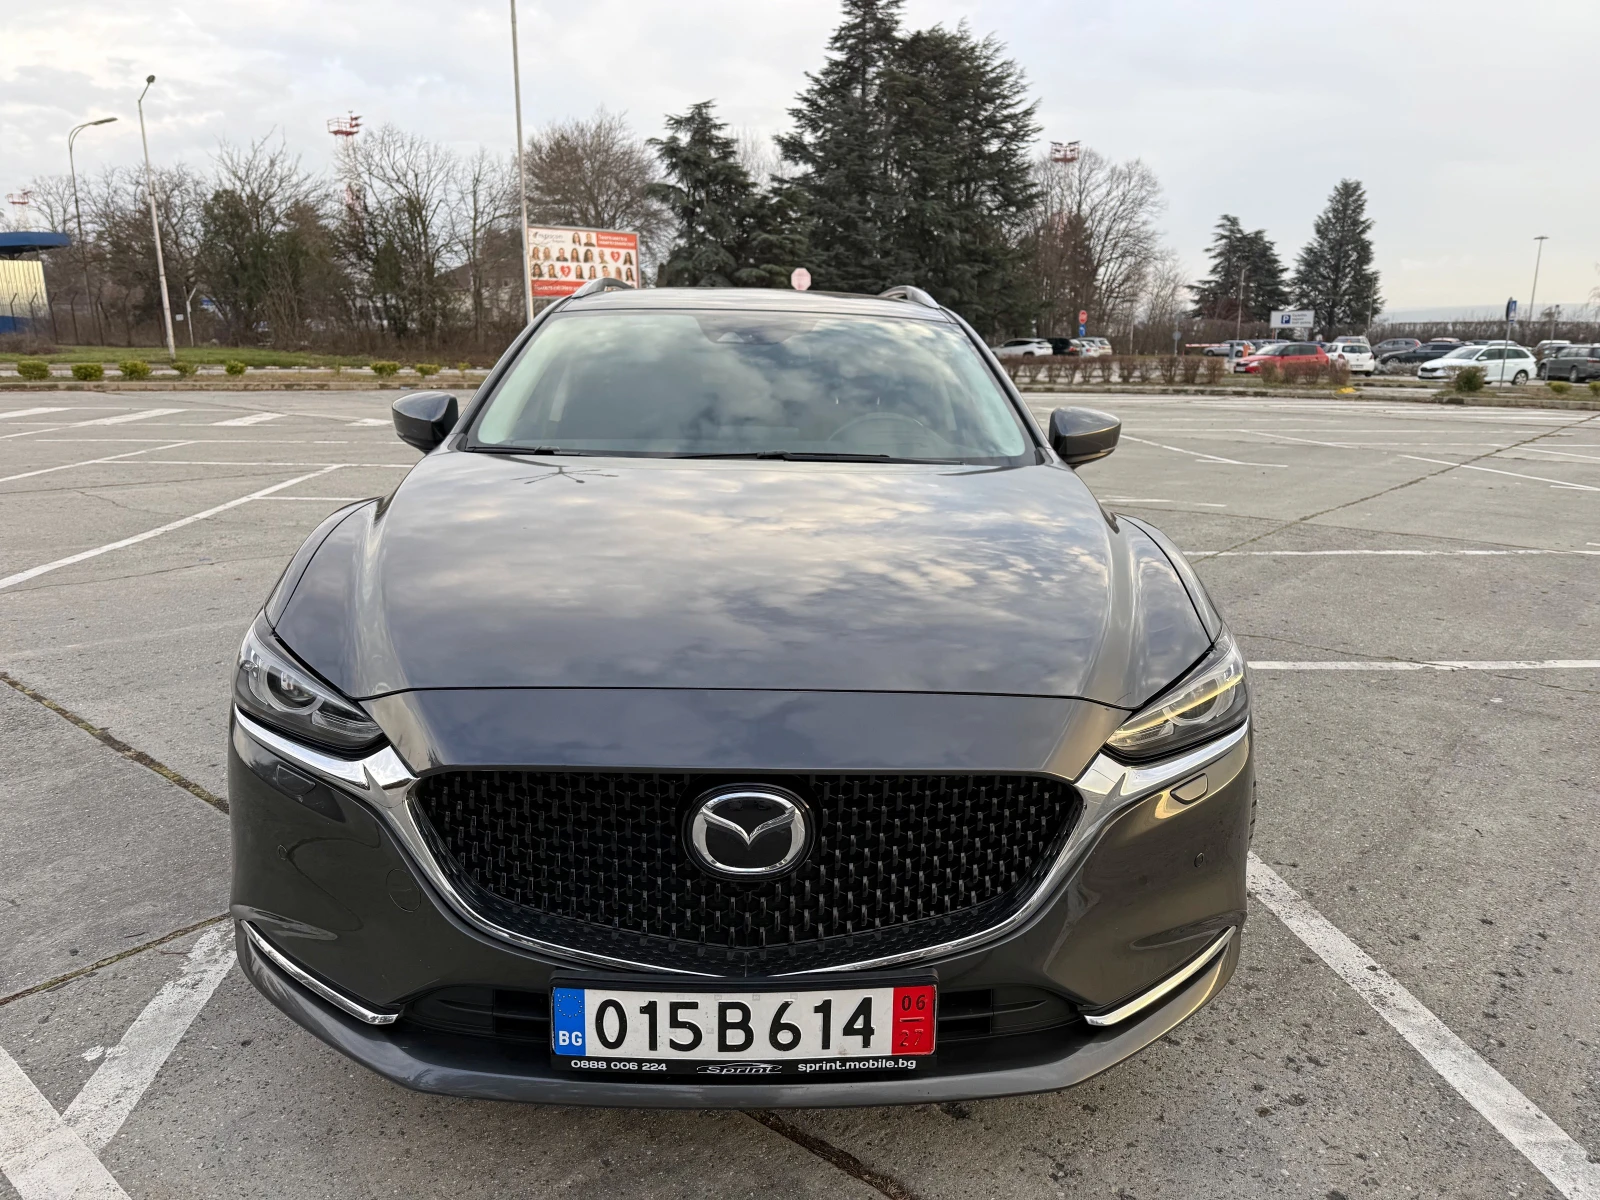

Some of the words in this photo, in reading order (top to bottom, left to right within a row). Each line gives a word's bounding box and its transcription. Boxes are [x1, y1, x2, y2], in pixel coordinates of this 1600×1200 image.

[901, 994, 926, 1011] 06
[558, 1030, 583, 1046] BG
[899, 1029, 924, 1046] 27
[570, 1060, 607, 1069] 0888
[610, 1062, 638, 1070] 006
[641, 1063, 667, 1071] 224
[706, 1065, 774, 1075] Sprint
[797, 1059, 917, 1073] sprint.mobile.bg
